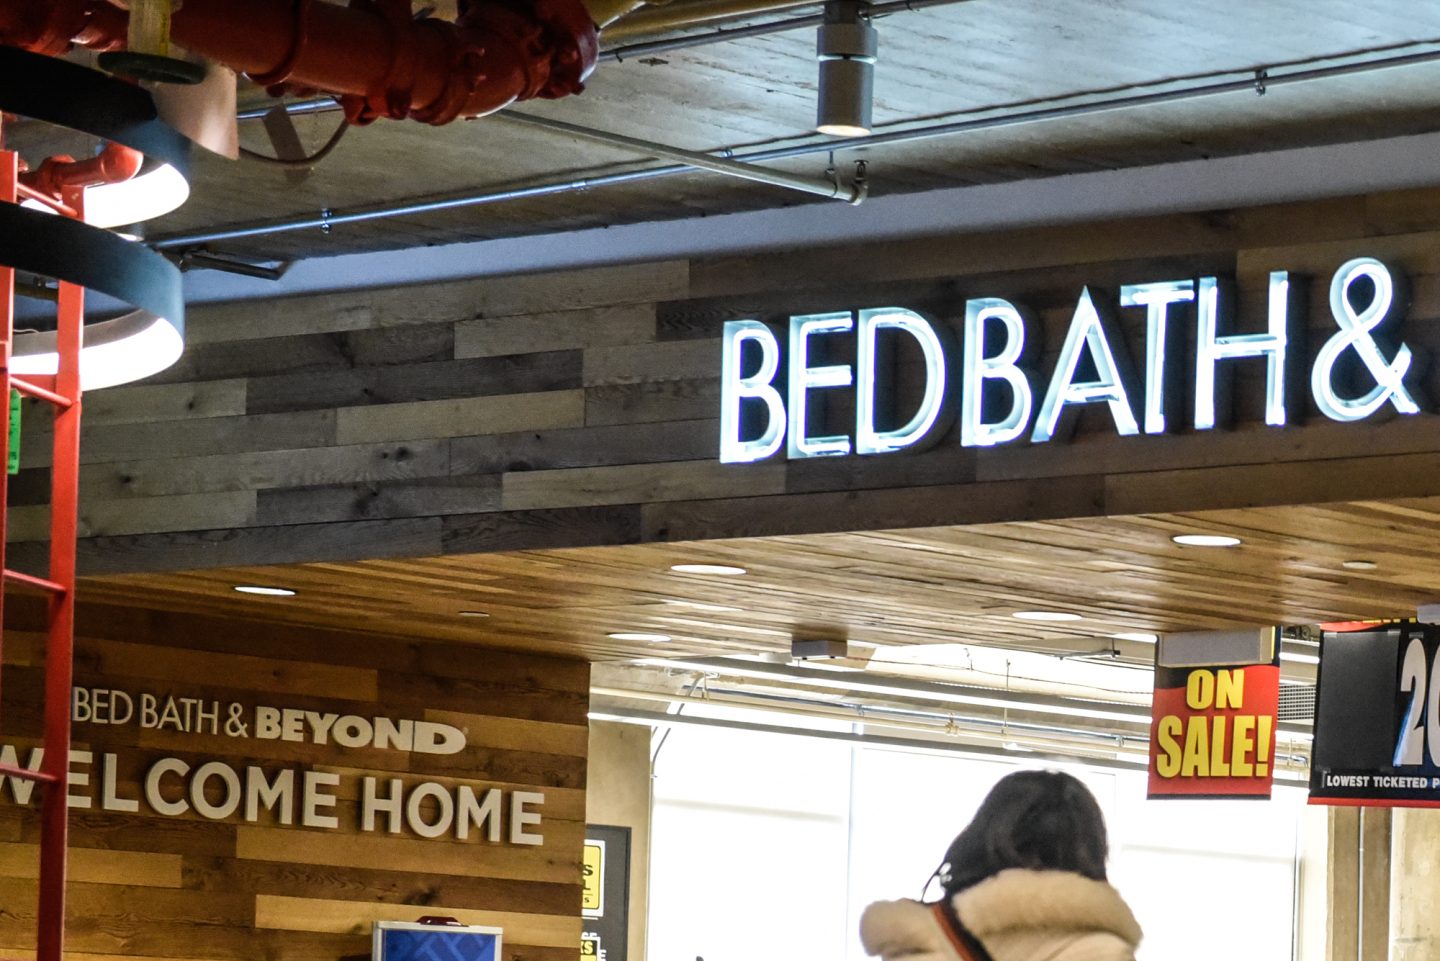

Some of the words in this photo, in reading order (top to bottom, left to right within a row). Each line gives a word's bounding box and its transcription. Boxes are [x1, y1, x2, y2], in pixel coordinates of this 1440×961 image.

[719, 307, 948, 464] BED
[960, 270, 1289, 448] BATH
[1310, 256, 1420, 423] &
[72, 686, 133, 726] BED
[141, 692, 220, 737] BATH
[224, 702, 249, 739] &
[255, 705, 467, 755] BEYOND
[1186, 668, 1245, 710] ON
[1156, 715, 1273, 778] SALE!
[361, 775, 545, 847] HOME
[1326, 775, 1369, 788] LOWEST
[1373, 776, 1428, 789] TICKETED
